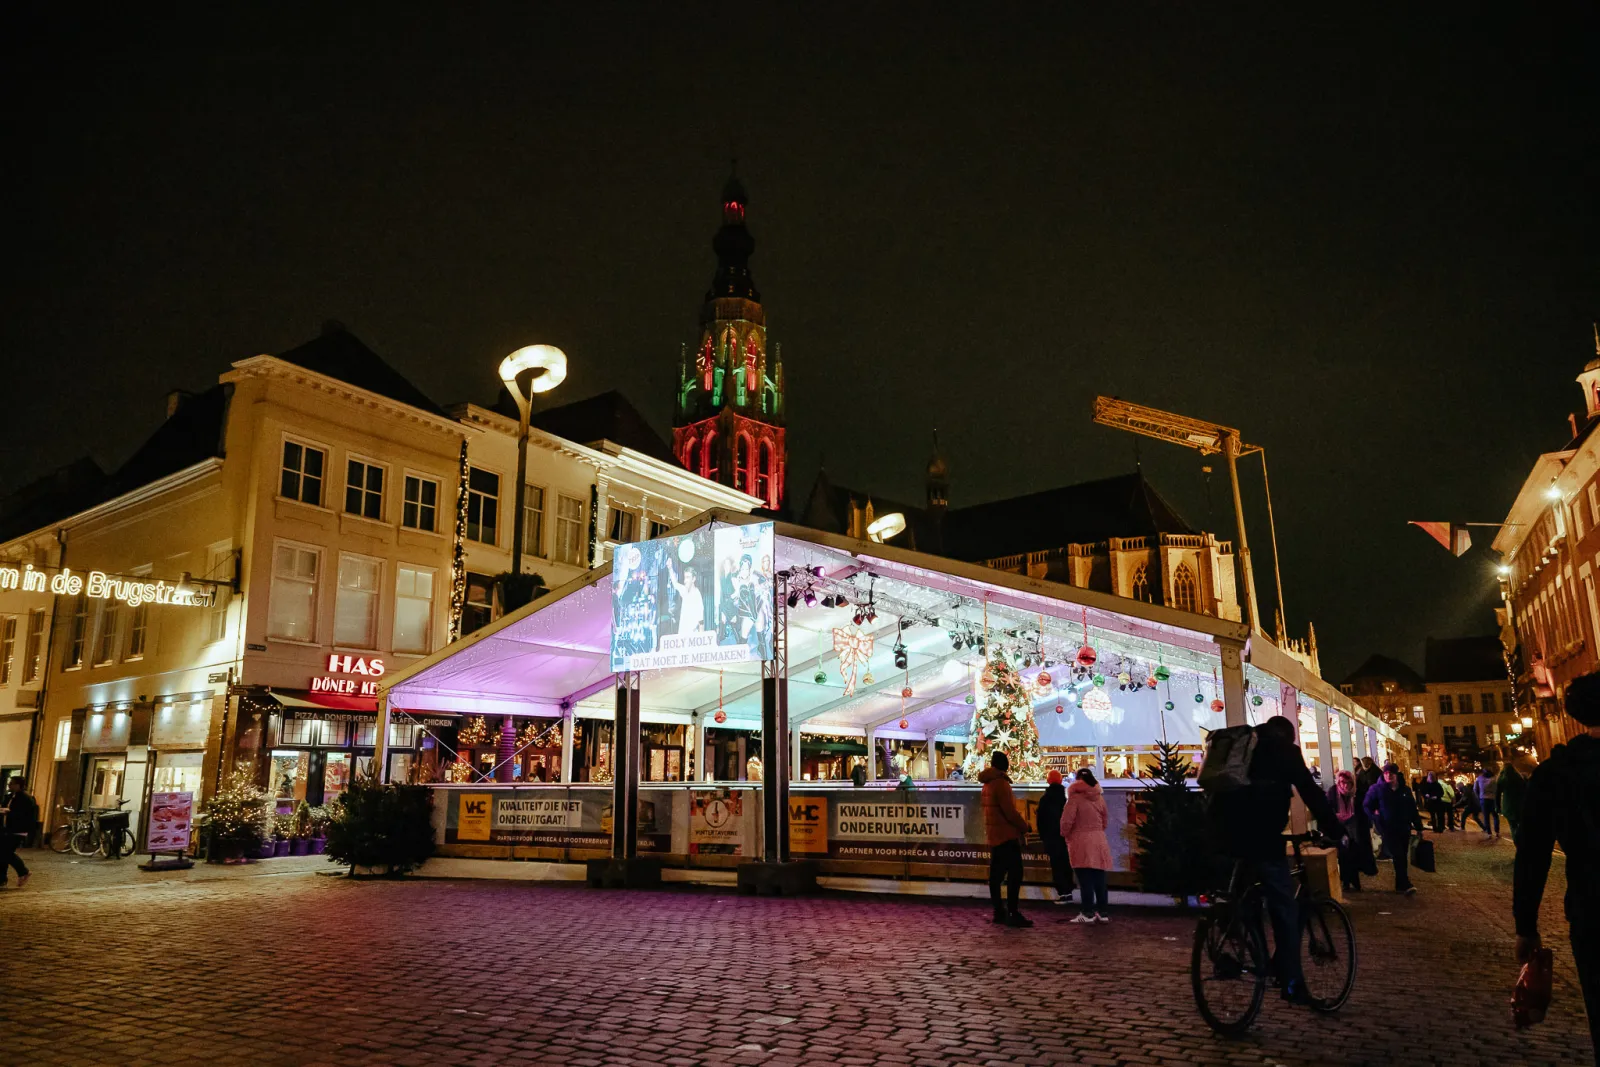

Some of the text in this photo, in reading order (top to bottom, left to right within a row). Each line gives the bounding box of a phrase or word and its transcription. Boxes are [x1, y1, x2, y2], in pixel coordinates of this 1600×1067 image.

[22, 564, 47, 592] in
[51, 568, 82, 596] de
[663, 635, 714, 650] HOLY MOLY
[329, 654, 385, 677] HAS
[633, 650, 746, 668] DAT MOET JE MEEMAKEN!
[361, 681, 377, 695] KE
[294, 711, 319, 720] PIZZA
[353, 714, 377, 723] KEBA
[389, 716, 417, 725] ALAFEL
[423, 718, 453, 727] CHICKEN
[465, 800, 487, 814] VHC
[500, 801, 543, 812] KWALITEIT
[544, 801, 559, 812] DIE
[840, 805, 961, 819] KWALITEIT DIE NIET
[839, 821, 940, 836] ONDERUITGAAT!
[839, 847, 873, 855] PARTNER
[875, 848, 897, 856] VOOR
[938, 850, 992, 859] GROOTVERBR
